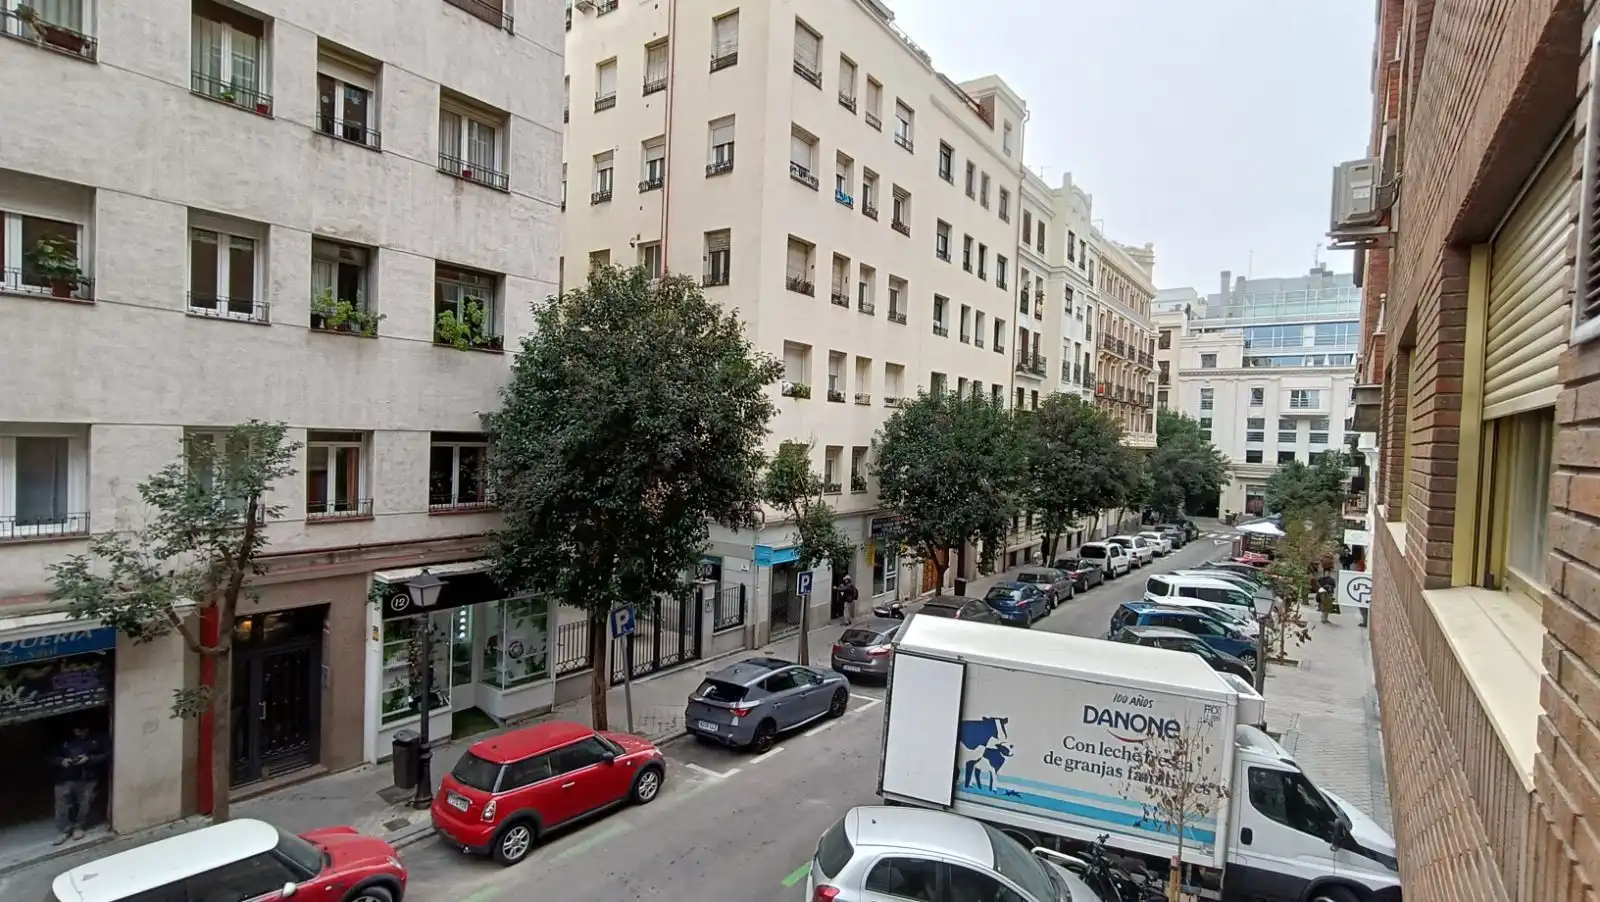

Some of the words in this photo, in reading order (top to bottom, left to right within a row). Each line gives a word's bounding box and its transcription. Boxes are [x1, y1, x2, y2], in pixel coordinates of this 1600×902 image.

[801, 575, 810, 593] P
[395, 598, 406, 607] 12
[615, 609, 630, 634] P
[1113, 692, 1128, 704] 100
[1128, 694, 1153, 708] AÑOS
[1063, 735, 1096, 755] Con
[1099, 741, 1142, 762] leche
[1043, 751, 1062, 766] de
[1065, 758, 1122, 778] granjas
